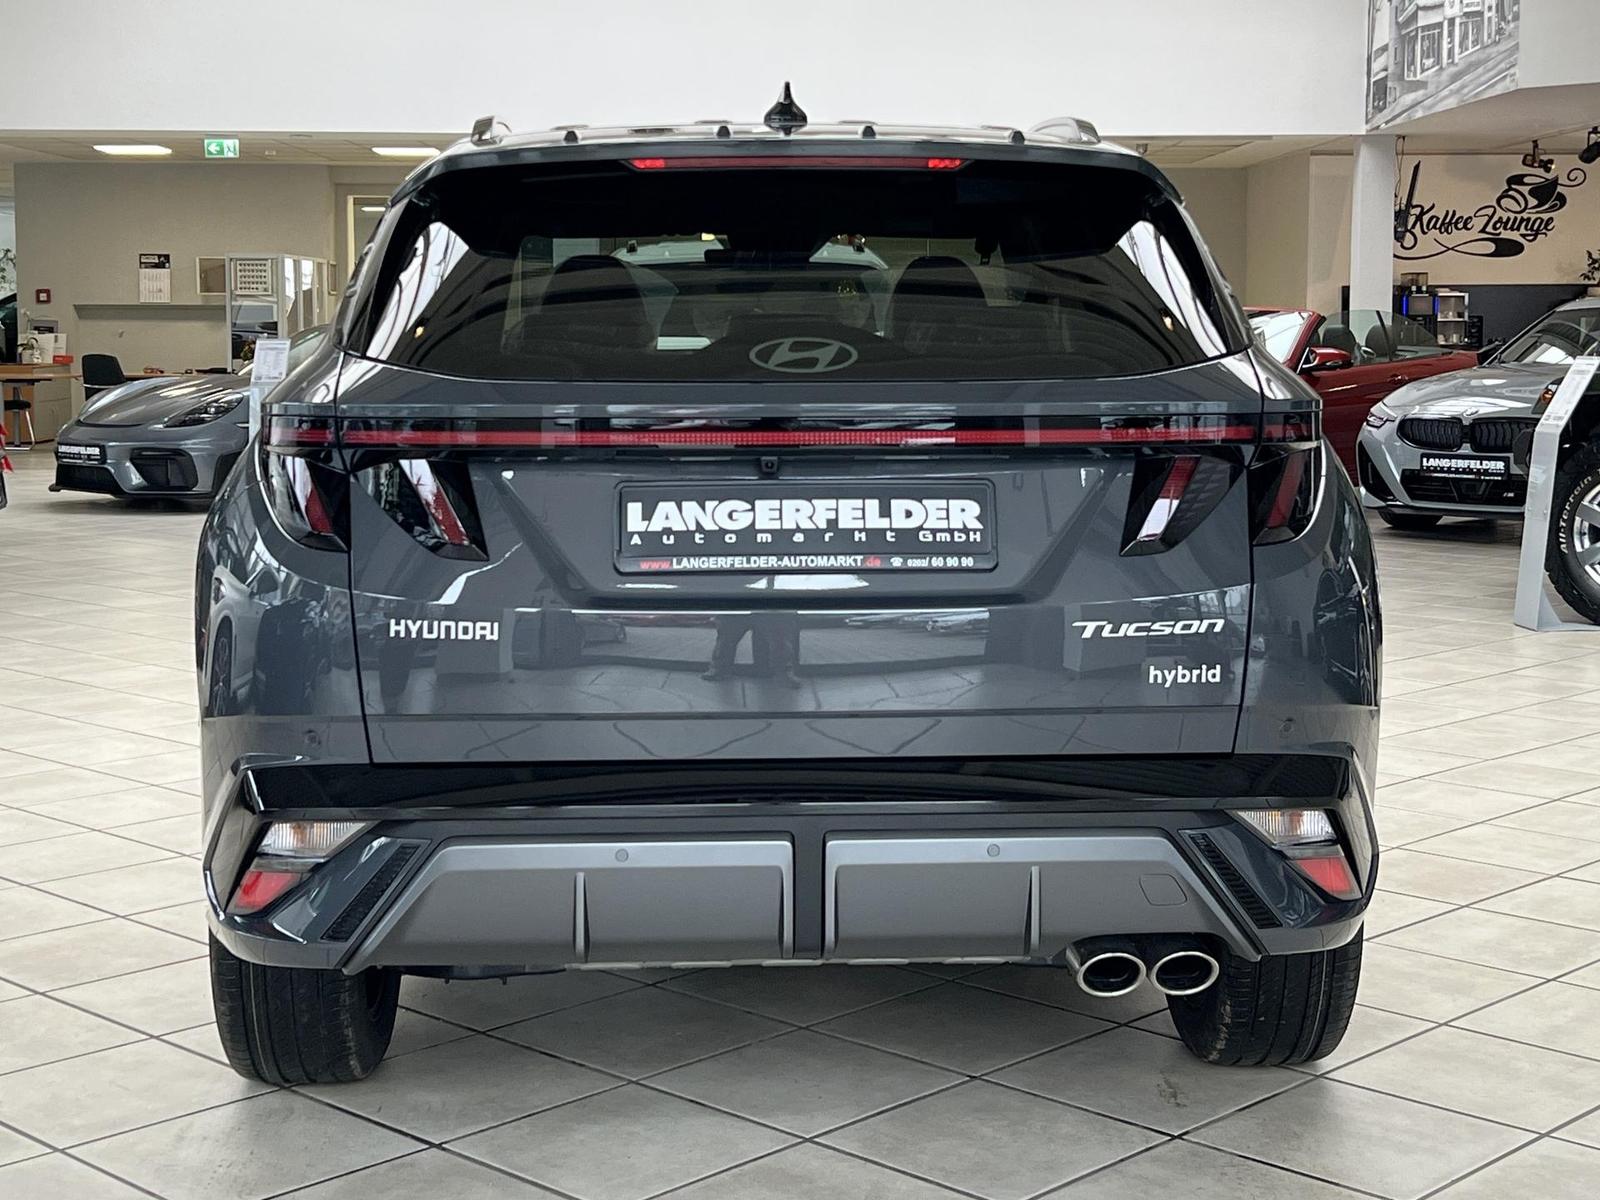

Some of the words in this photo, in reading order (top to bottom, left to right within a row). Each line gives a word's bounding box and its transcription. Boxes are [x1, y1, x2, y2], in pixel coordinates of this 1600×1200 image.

[1411, 203, 1474, 235] Kaffee
[1474, 205, 1555, 242] Lounge
[1422, 457, 1505, 470] LANGERFELDER
[626, 498, 984, 532] LANGERFELDER
[389, 618, 499, 641] HYUNDAI
[1149, 664, 1221, 688] hybrid
